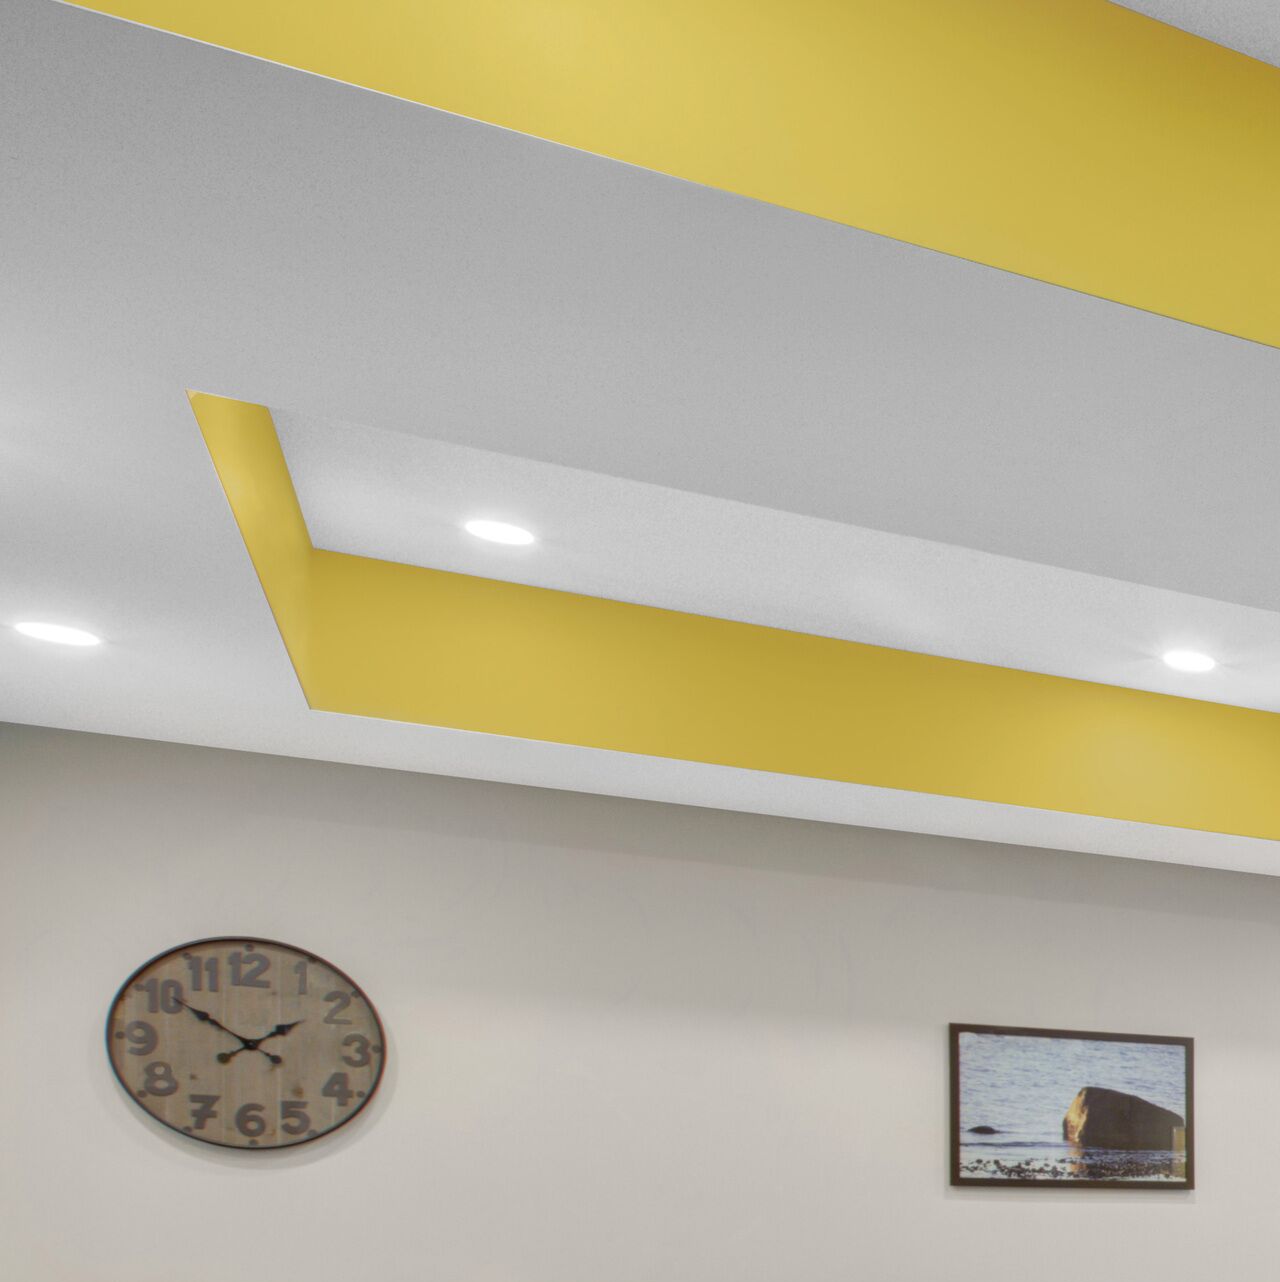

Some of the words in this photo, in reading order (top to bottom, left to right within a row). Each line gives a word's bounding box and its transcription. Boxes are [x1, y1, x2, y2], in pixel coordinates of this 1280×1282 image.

[188, 956, 219, 992] 11
[227, 952, 271, 989] 12
[294, 960, 307, 995] 1
[145, 978, 183, 1015] 10
[322, 990, 353, 1025] 2
[125, 1021, 158, 1056] 9
[341, 1034, 372, 1068] 3
[144, 1061, 179, 1097] 8
[321, 1072, 354, 1107] 4
[190, 1094, 221, 1130] 7
[235, 1103, 266, 1138] 6
[280, 1101, 311, 1136] 5
